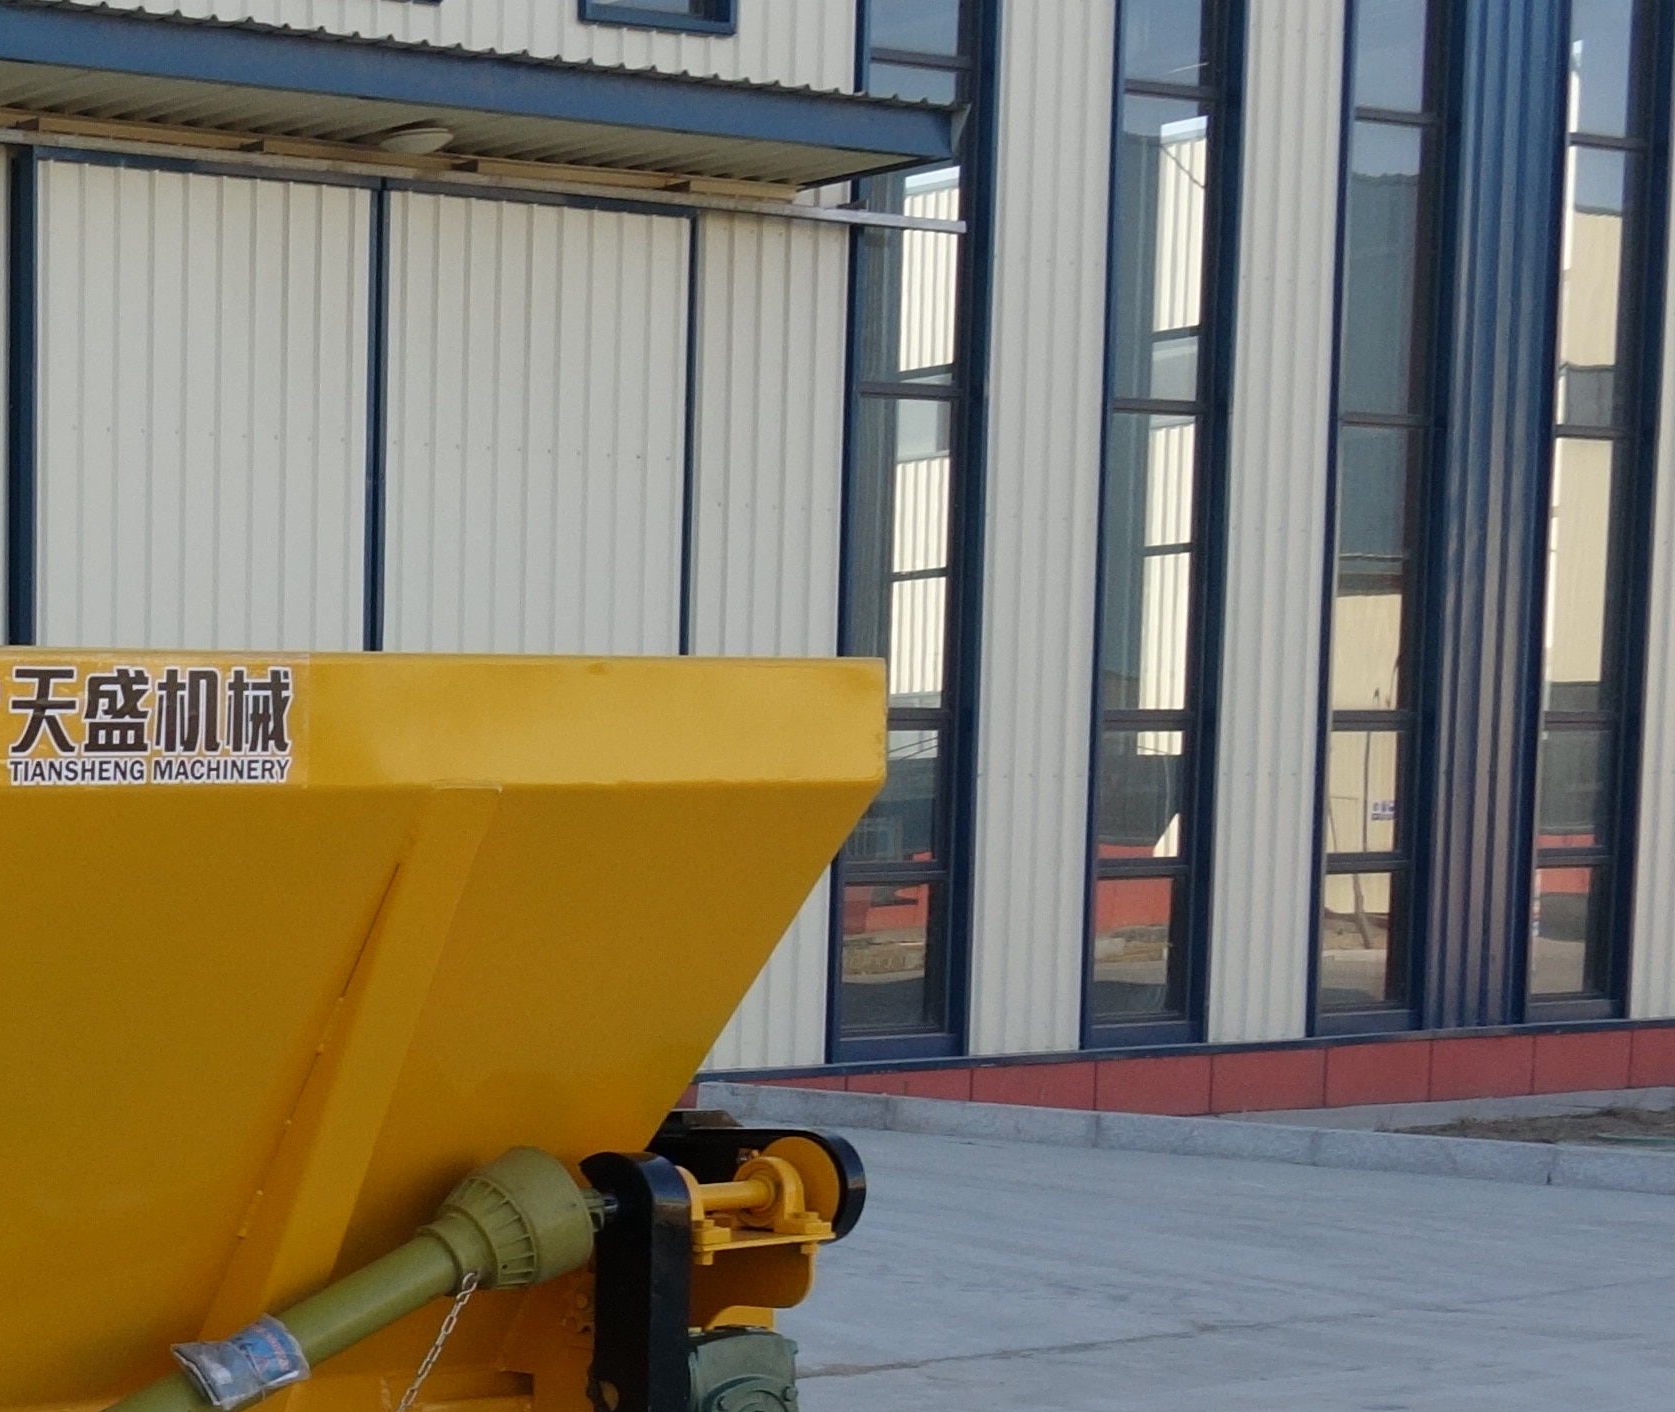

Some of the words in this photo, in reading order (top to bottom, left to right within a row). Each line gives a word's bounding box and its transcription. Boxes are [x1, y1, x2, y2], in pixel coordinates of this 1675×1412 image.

[10, 667, 290, 753] 天盛机械
[10, 759, 145, 783] TIANSHENG
[153, 758, 290, 781] MACHINERY
